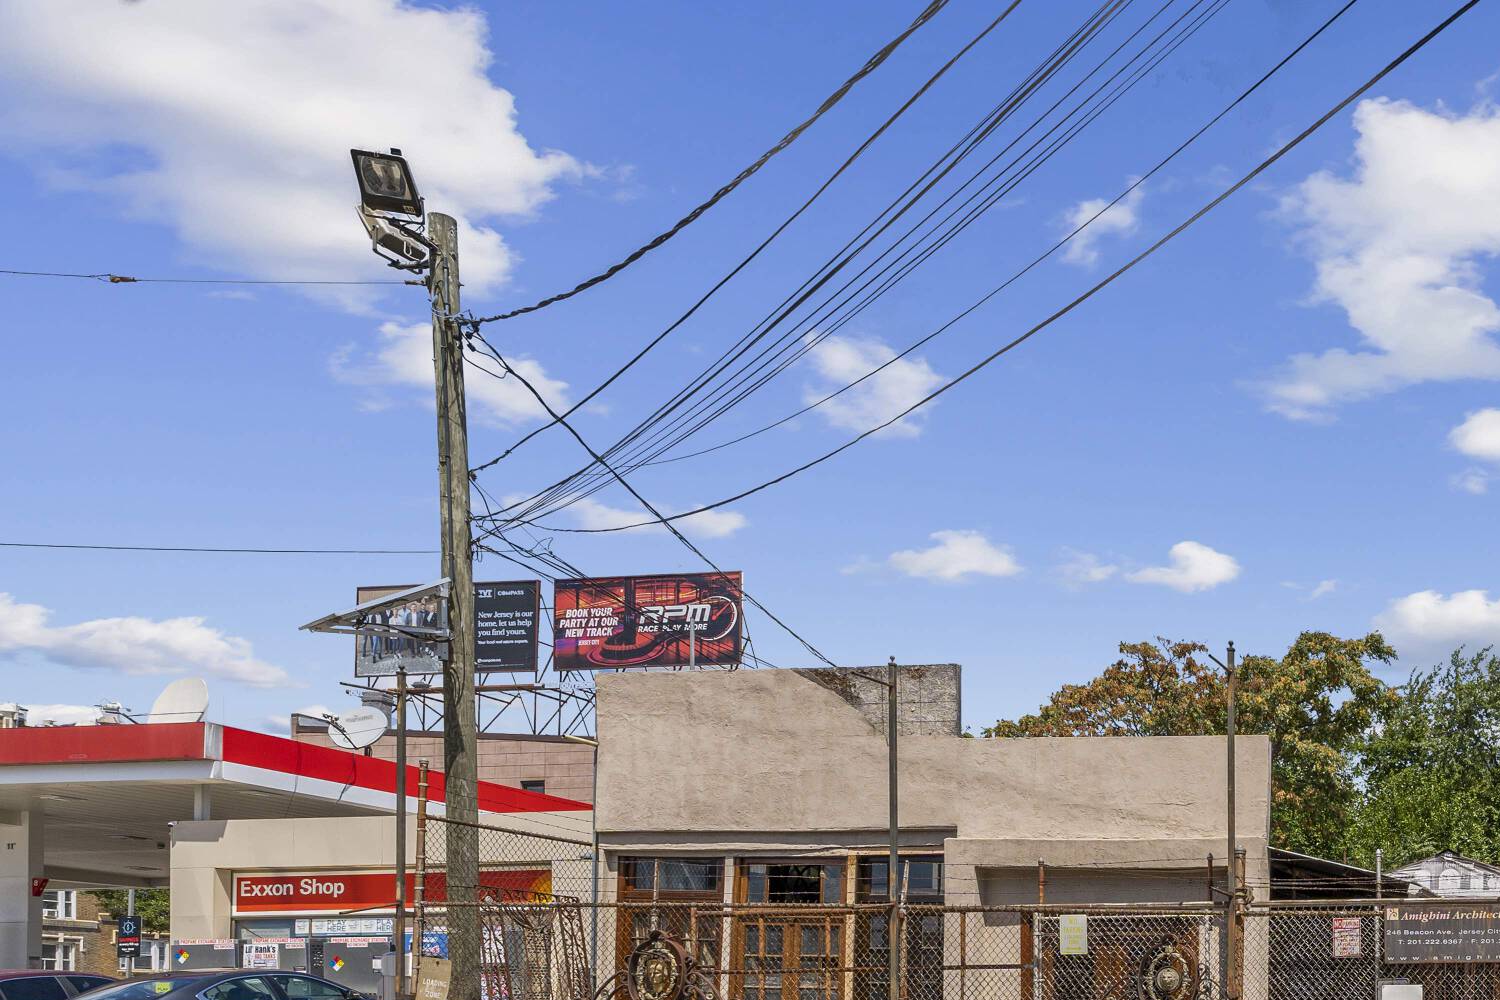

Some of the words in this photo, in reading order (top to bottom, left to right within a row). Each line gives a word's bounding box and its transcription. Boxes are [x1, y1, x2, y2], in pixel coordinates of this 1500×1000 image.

[493, 611, 514, 619] Jersey
[565, 608, 590, 618] BOOK
[590, 607, 613, 617] YOUR
[640, 604, 711, 624] RPM
[498, 619, 507, 627] let
[517, 619, 532, 627] help
[560, 618, 587, 628] PARTY
[588, 618, 600, 627] AT
[601, 617, 619, 626] OUR
[478, 629, 491, 637] you
[491, 628, 505, 636] find
[506, 629, 527, 637] yours.
[565, 628, 585, 638] NEW
[586, 627, 613, 637] TRACK
[638, 625, 659, 633] RACE
[240, 880, 294, 897] Exxon
[299, 878, 345, 898] Shop
[1400, 911, 1451, 923] Amighini
[1458, 928, 1486, 936] Jersey
[425, 990, 441, 999] ZONE
